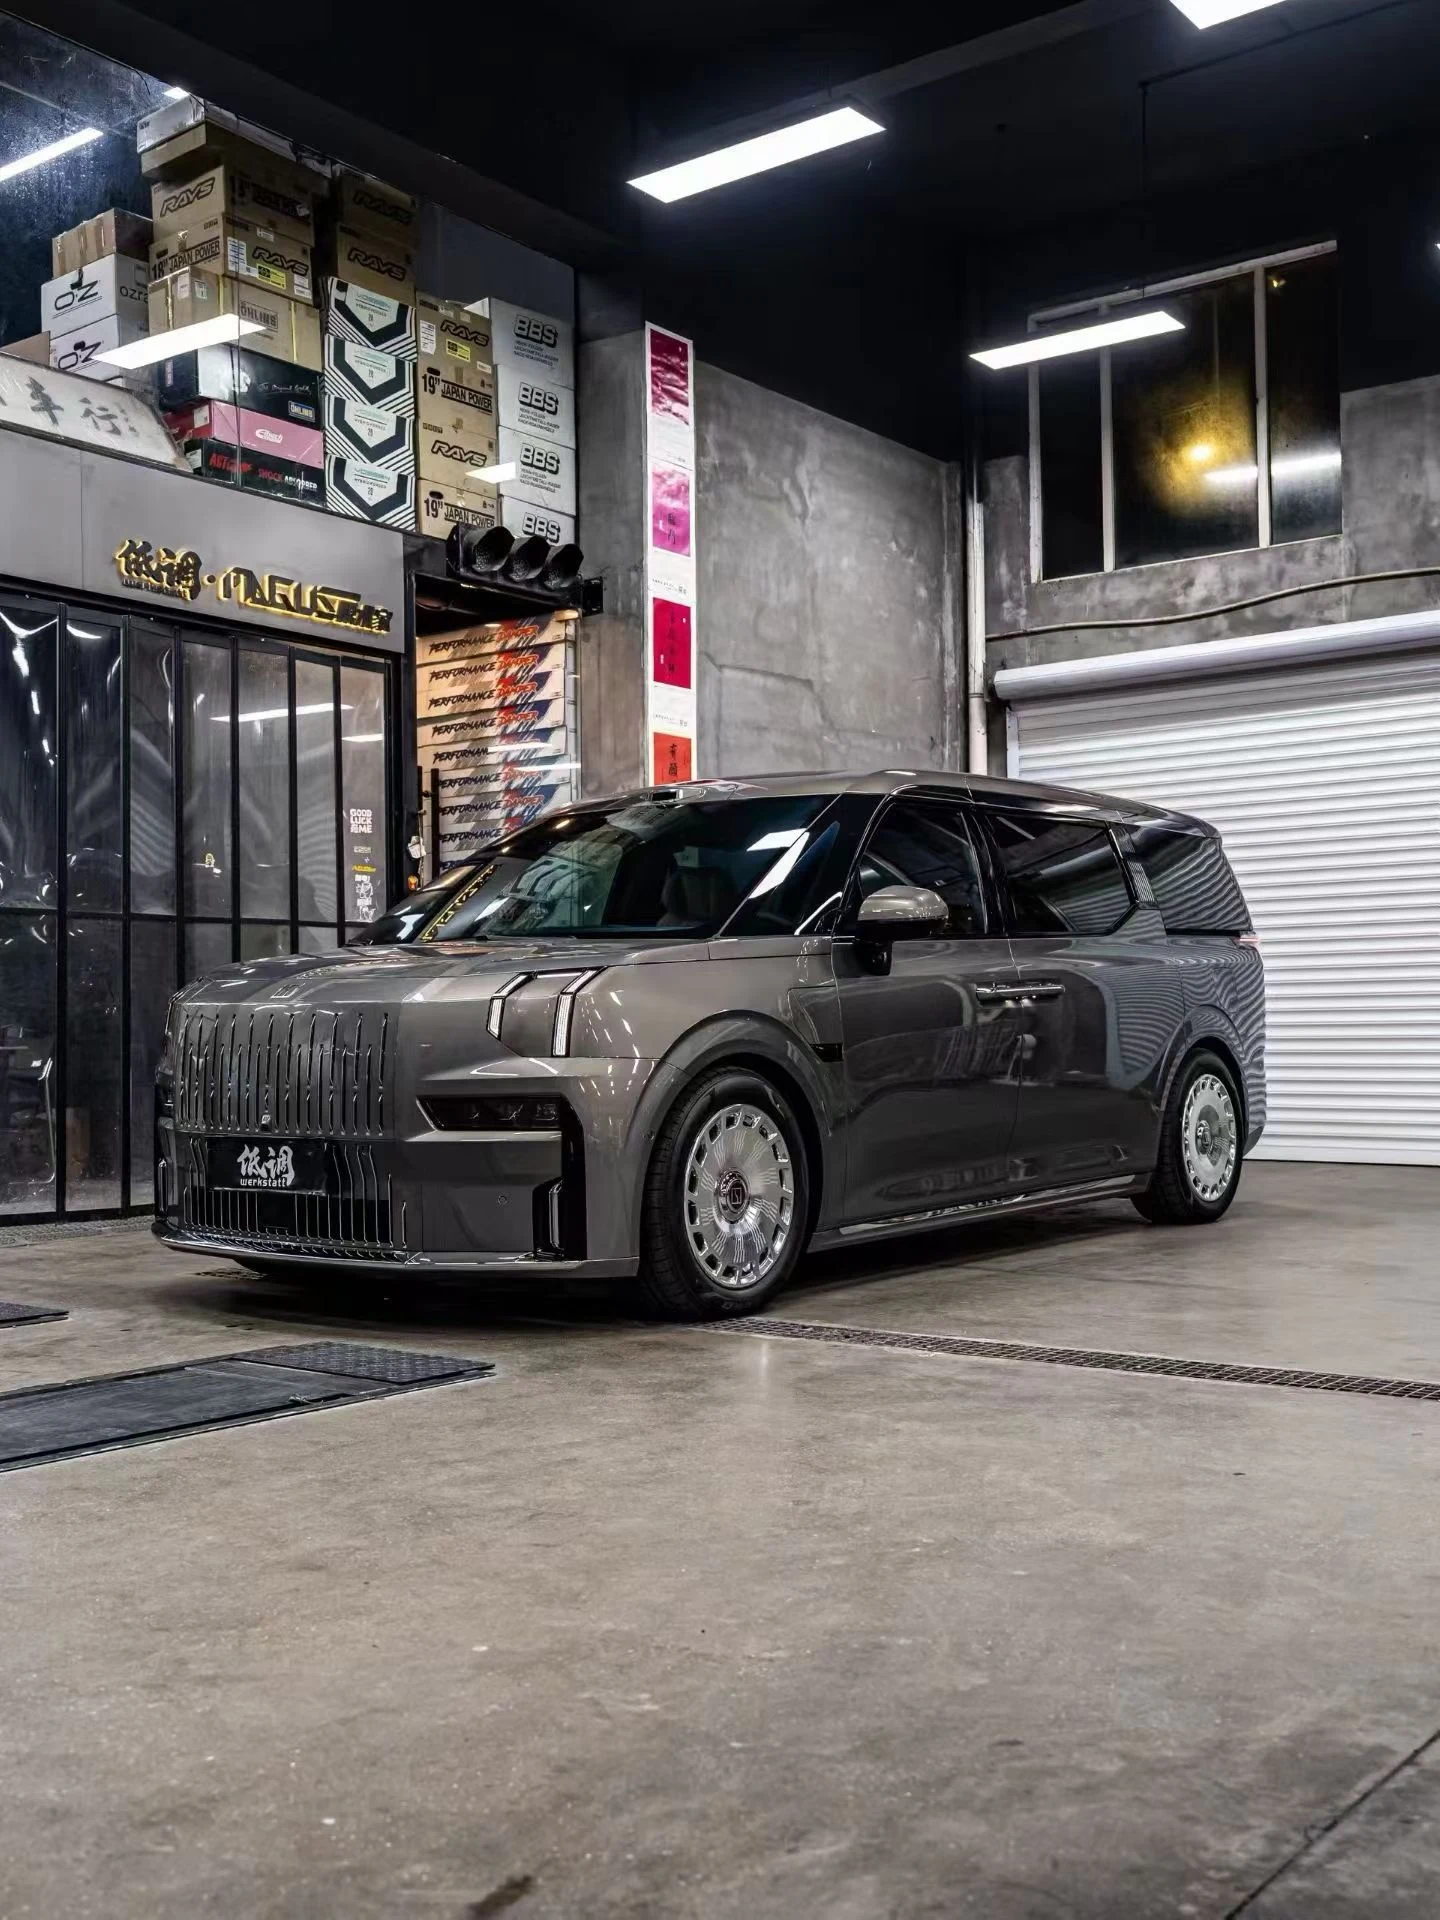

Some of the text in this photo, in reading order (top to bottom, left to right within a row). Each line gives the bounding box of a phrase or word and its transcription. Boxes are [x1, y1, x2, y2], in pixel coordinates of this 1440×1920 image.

[160, 177, 215, 217] RAYS
[169, 251, 192, 272] JAPAN
[194, 240, 221, 261] POWER
[252, 246, 309, 277] RAYS
[348, 247, 407, 282] RAYS
[440, 319, 489, 347] RAYS
[514, 314, 558, 348] BBS
[441, 383, 467, 400] JAPAN
[468, 391, 492, 410] POWER
[518, 382, 558, 415] BBS
[431, 440, 487, 467] RAYS
[521, 443, 560, 475] BBS
[444, 506, 469, 522] JAPAN
[471, 515, 495, 528] POWER
[523, 512, 560, 544] BBS
[428, 633, 496, 655] PERFORMANCE
[428, 654, 539, 683] PERFORMANCE DAMPER
[428, 682, 538, 710] PERFORMANCE DAMPER
[431, 711, 538, 737] PERFORMANCE DAMPER
[350, 808, 372, 817] GOOD
[350, 817, 372, 825] LUCK
[237, 1144, 295, 1186] 低调
[240, 1178, 286, 1187] werkstatt
